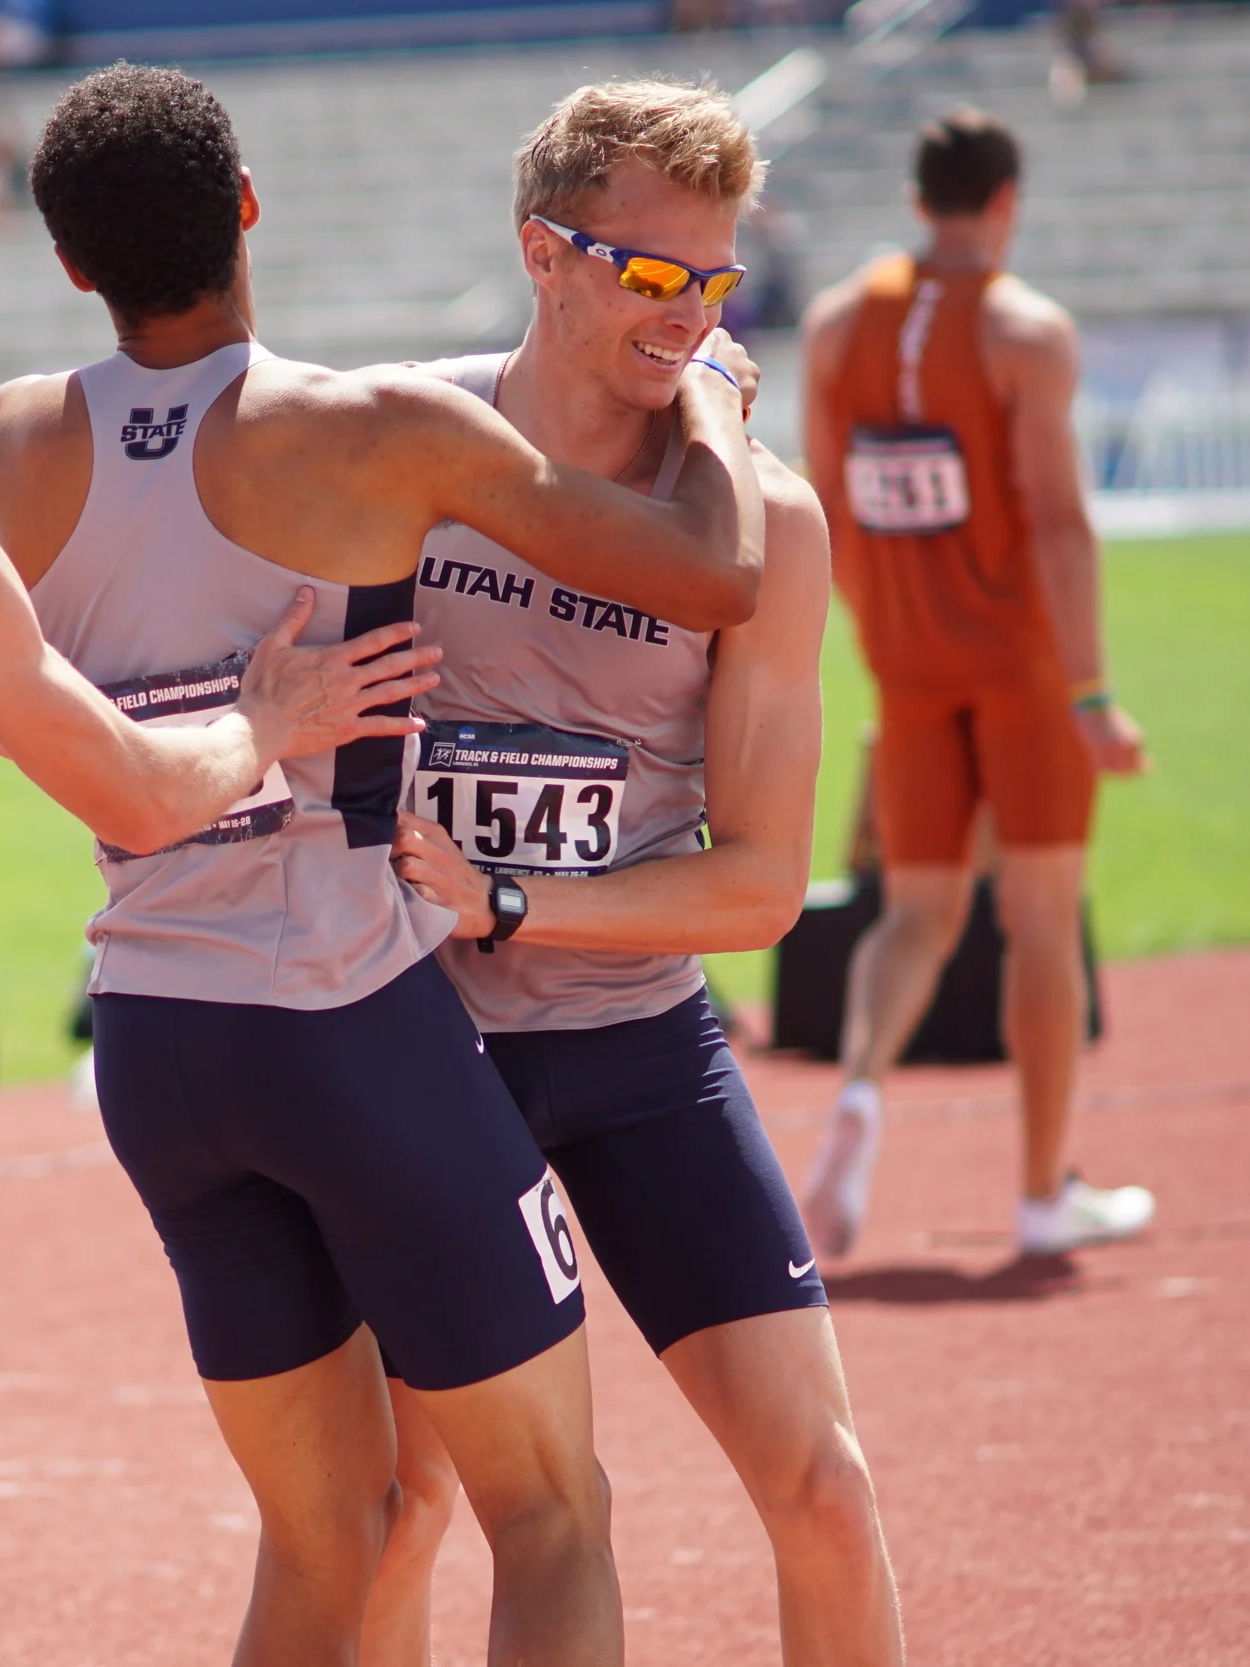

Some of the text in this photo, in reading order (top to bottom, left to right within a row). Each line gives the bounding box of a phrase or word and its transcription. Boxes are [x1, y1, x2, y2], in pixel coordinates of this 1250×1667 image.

[120, 419, 188, 442] STATE
[418, 556, 670, 647] UTAH STATE
[117, 692, 148, 711] FIELD
[149, 675, 240, 704] CHAMPIONSHIPS
[455, 749, 619, 770] TRACK & FIELD CHAMPIONSHIPS
[218, 819, 231, 830] MAY
[427, 777, 614, 862] 1543
[540, 1180, 578, 1281] 6
